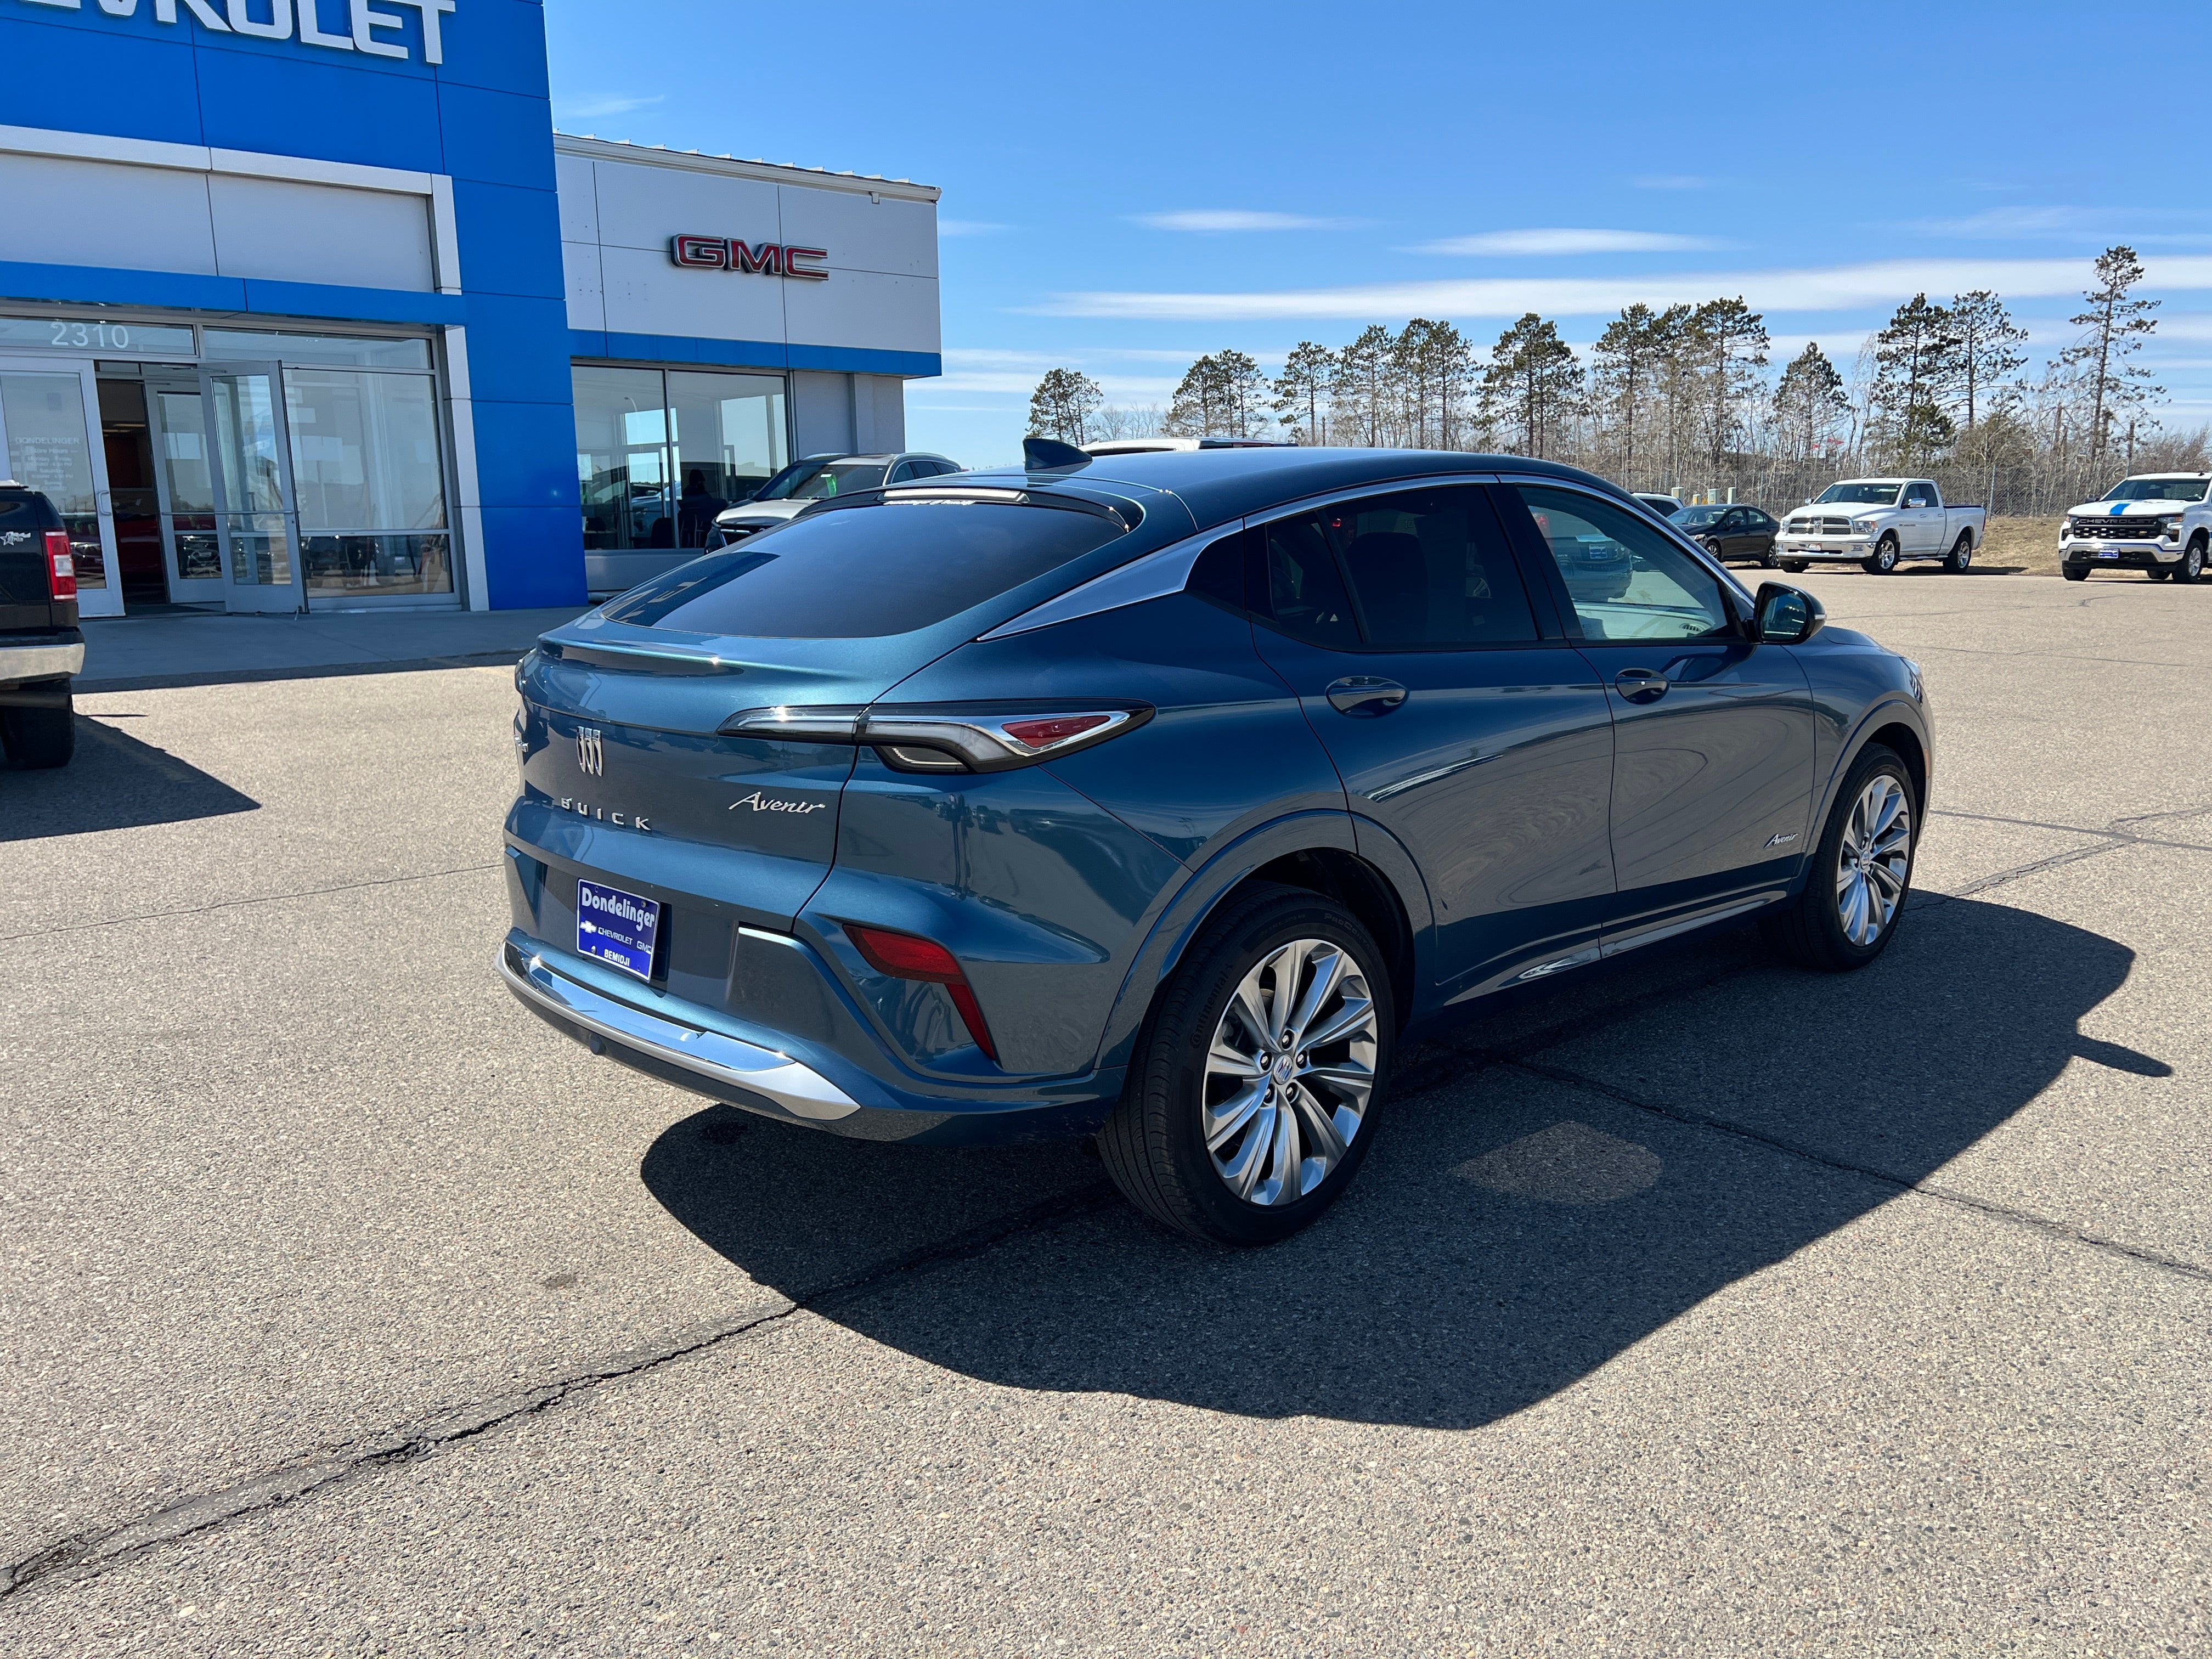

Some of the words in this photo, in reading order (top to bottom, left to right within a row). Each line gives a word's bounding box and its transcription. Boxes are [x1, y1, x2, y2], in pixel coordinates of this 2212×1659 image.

[670, 233, 830, 280] GMC
[50, 320, 129, 348] 2310
[561, 797, 651, 831] BUICK
[728, 791, 826, 814] Avenir
[1763, 833, 1798, 849] Avenir
[582, 887, 655, 932] Dondelinger
[597, 927, 633, 945] CHEVROLET
[636, 940, 653, 955] GMC
[604, 949, 630, 967] BEMIDJI
